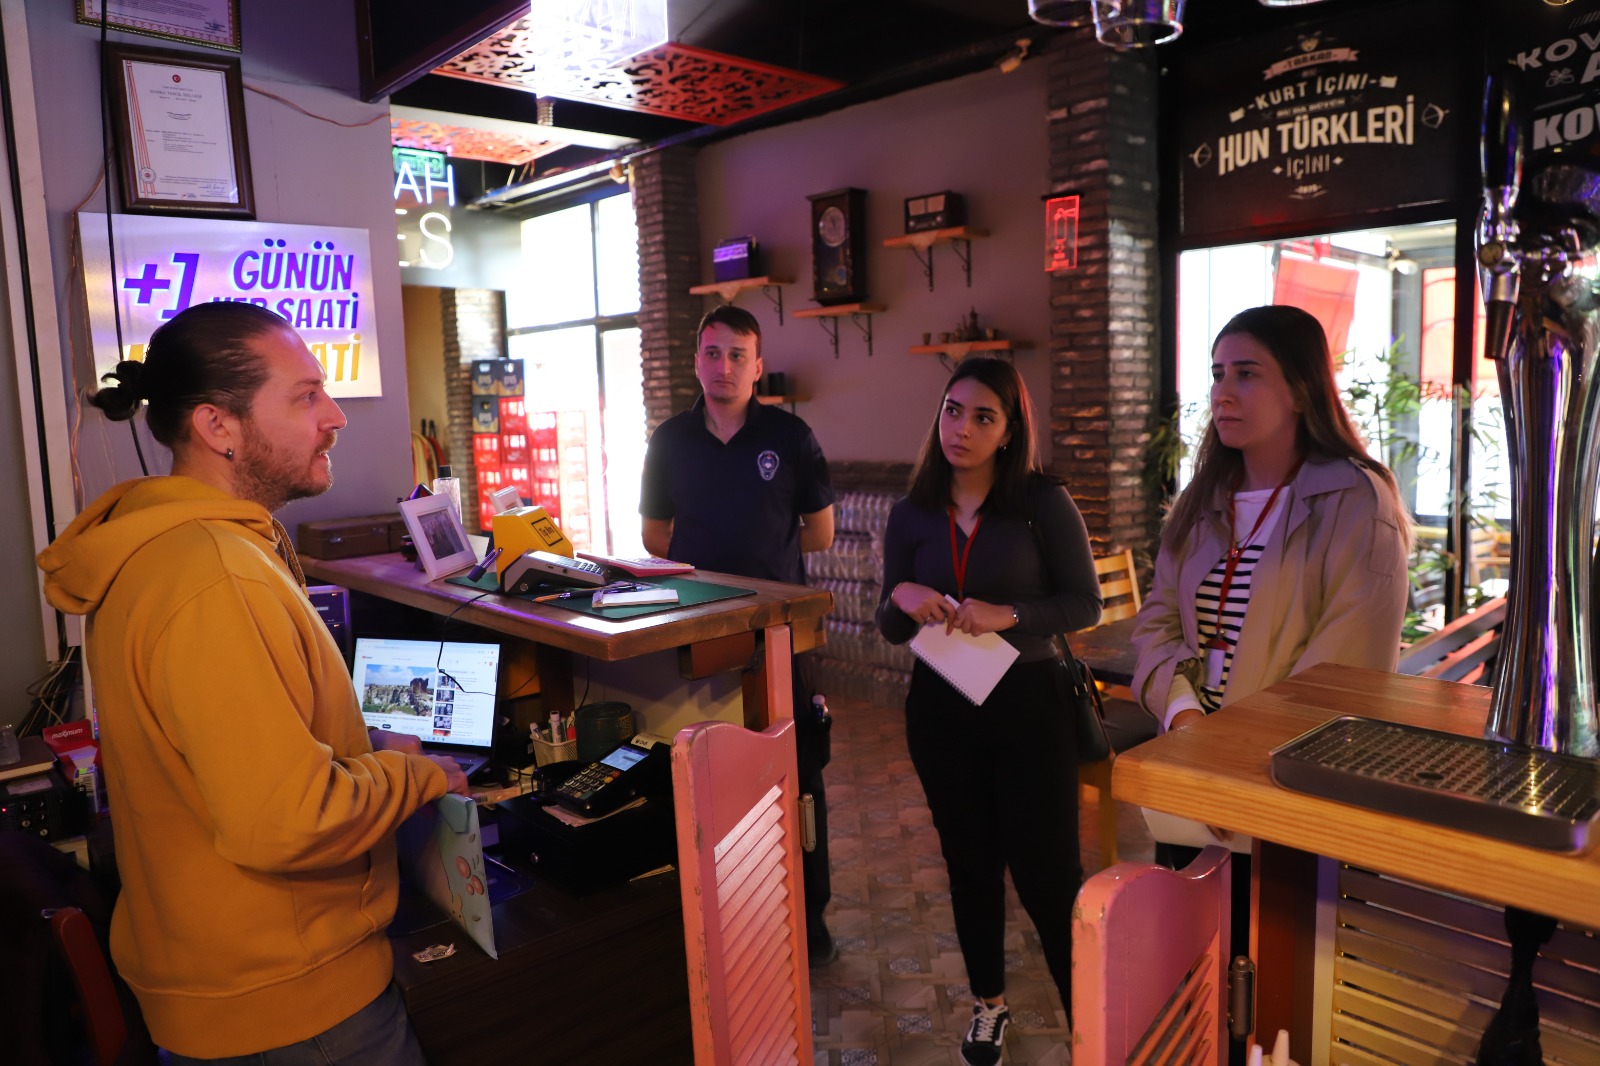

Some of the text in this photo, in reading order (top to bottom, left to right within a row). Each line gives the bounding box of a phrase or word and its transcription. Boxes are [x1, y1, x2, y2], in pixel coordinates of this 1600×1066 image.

[1255, 82, 1308, 110] KURT
[1218, 95, 1414, 176] HUN TÜRKLERİ
[1532, 103, 1600, 150] KO
[233, 238, 354, 291] GÜNÜN
[276, 291, 359, 329] SAATİ
